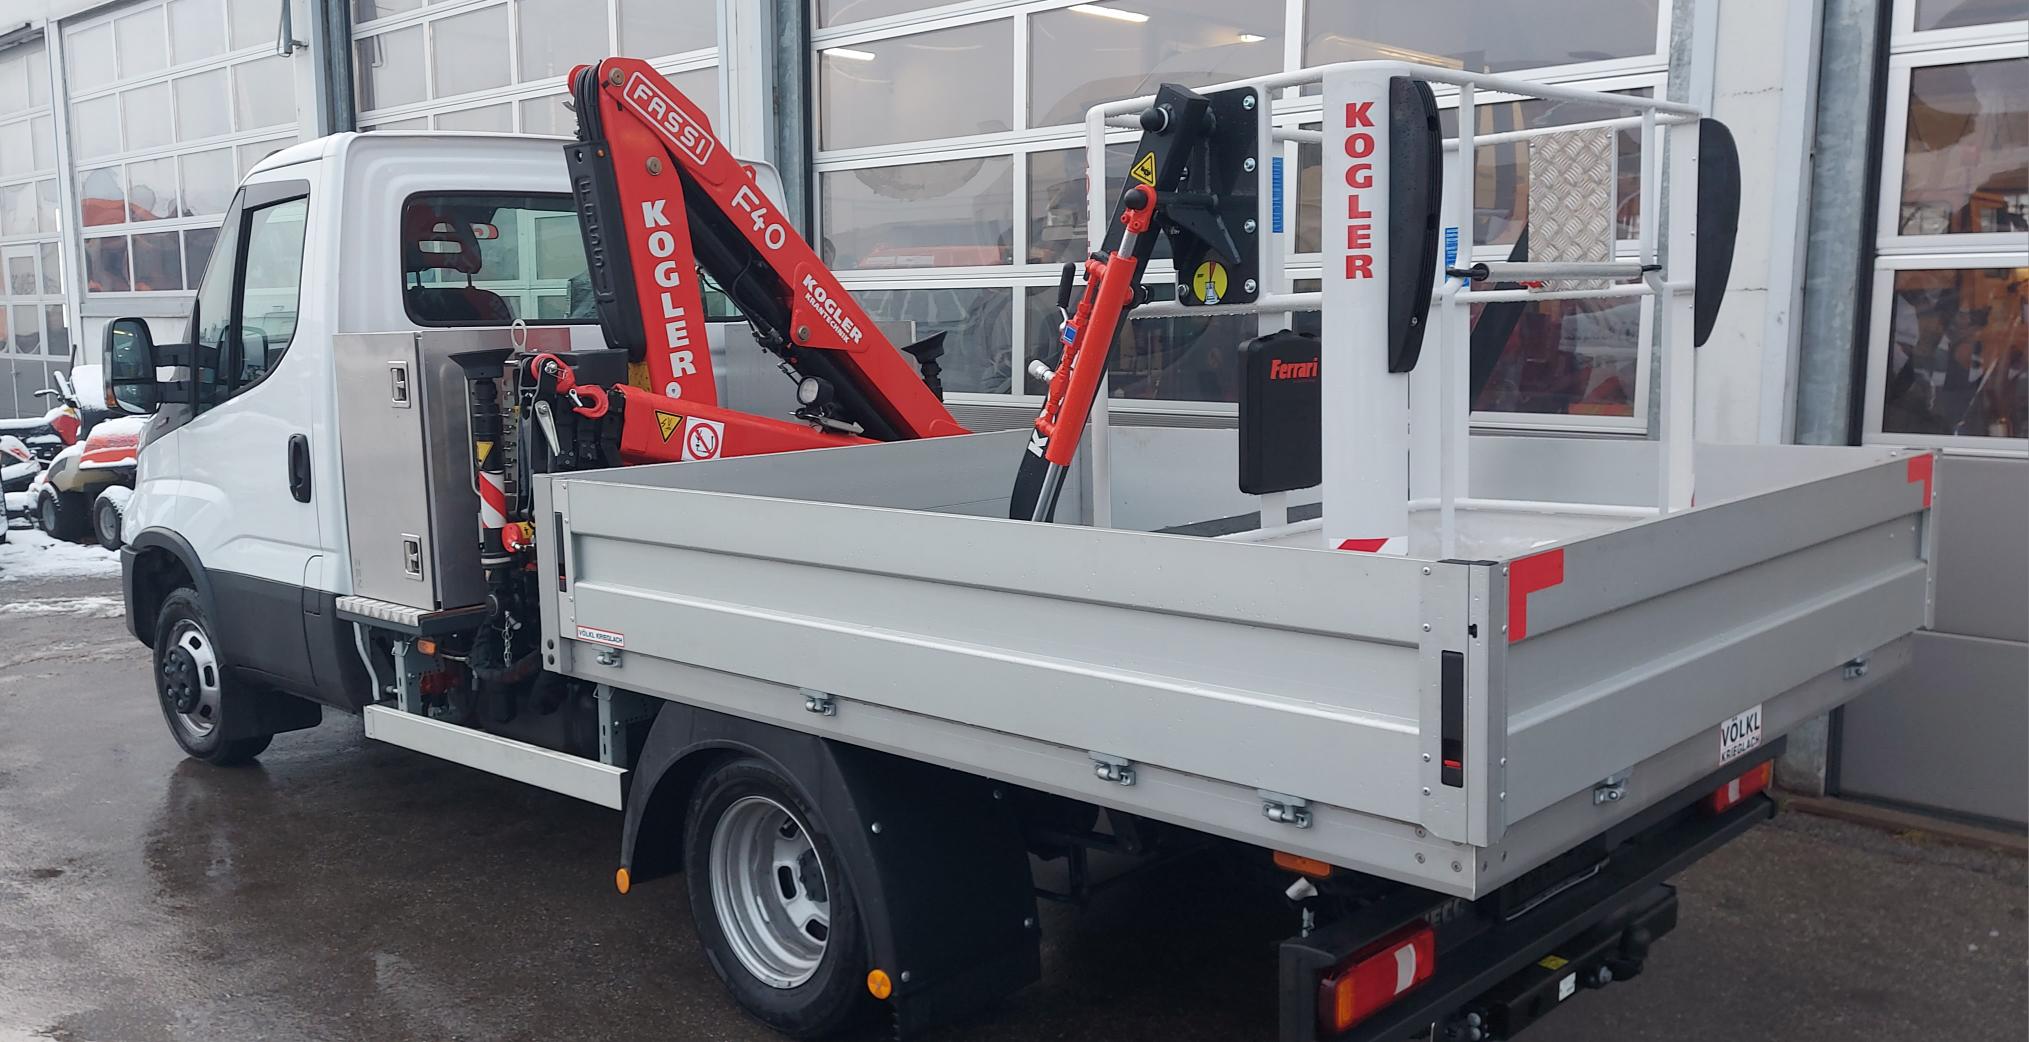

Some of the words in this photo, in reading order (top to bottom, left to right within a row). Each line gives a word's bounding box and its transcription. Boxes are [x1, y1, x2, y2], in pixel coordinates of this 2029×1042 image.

[633, 83, 706, 155] FASSI
[731, 184, 786, 250] F40
[1344, 101, 1376, 280] KOGLER
[641, 199, 697, 378] KOGLER
[802, 273, 863, 344] KOGLER
[804, 292, 850, 343] KRANTECHNIK
[1270, 357, 1318, 380] Ferrari
[1721, 711, 1760, 747] VÖLKL
[1721, 735, 1760, 761] KRIEGLACH
